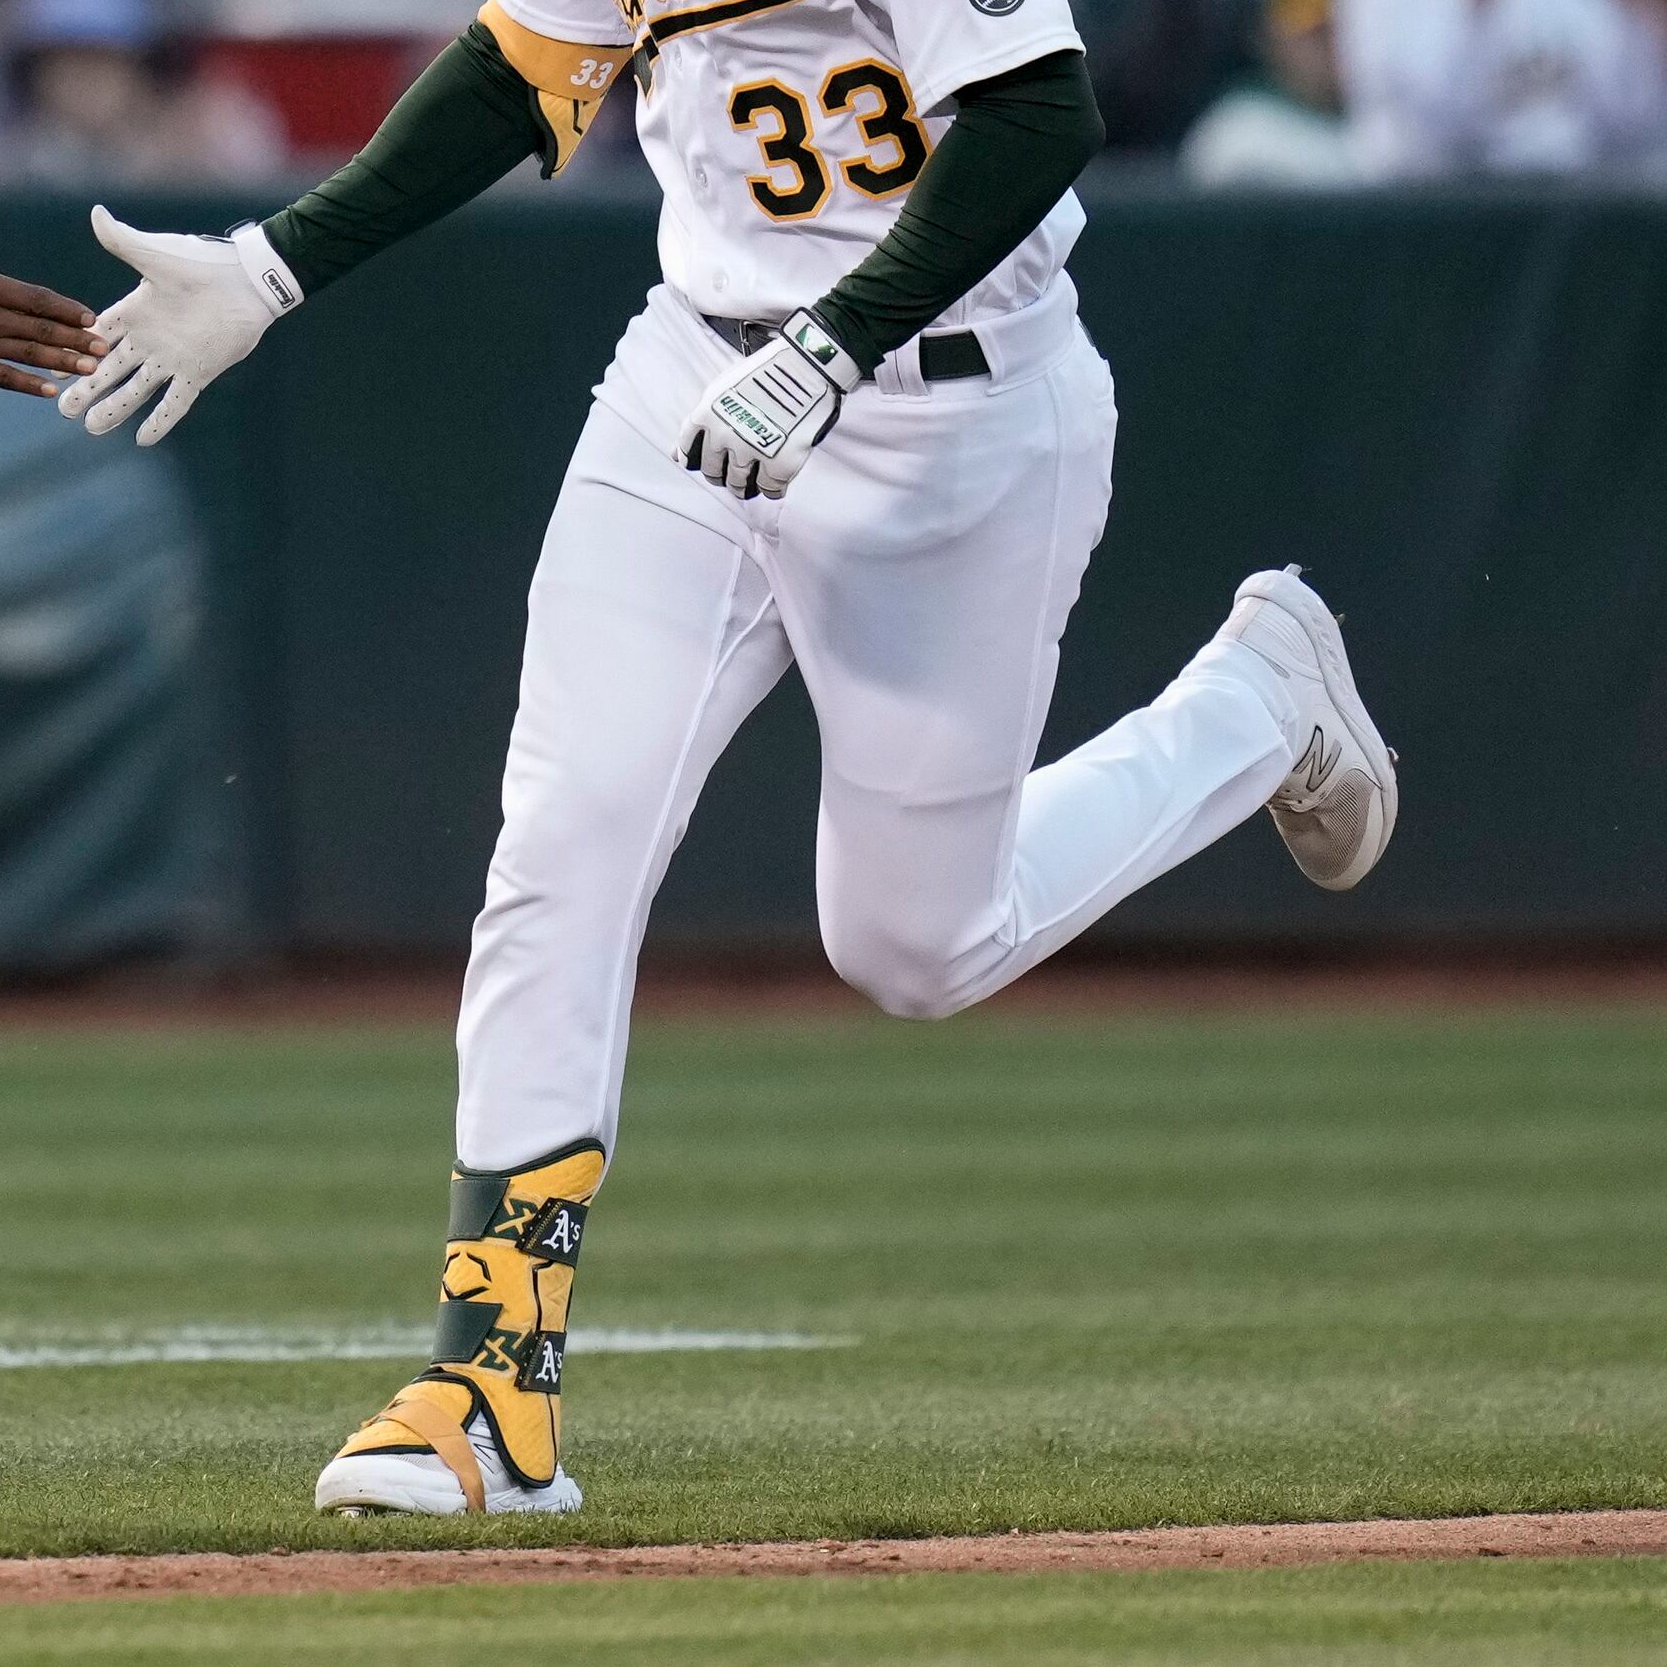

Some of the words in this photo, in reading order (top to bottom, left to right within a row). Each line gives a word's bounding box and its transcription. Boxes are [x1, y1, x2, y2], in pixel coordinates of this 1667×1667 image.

[570, 58, 614, 89] 33
[726, 57, 934, 223] 33
[720, 395, 782, 448] Franklin
[541, 1209, 581, 1253] A's
[535, 1340, 563, 1383] A's
